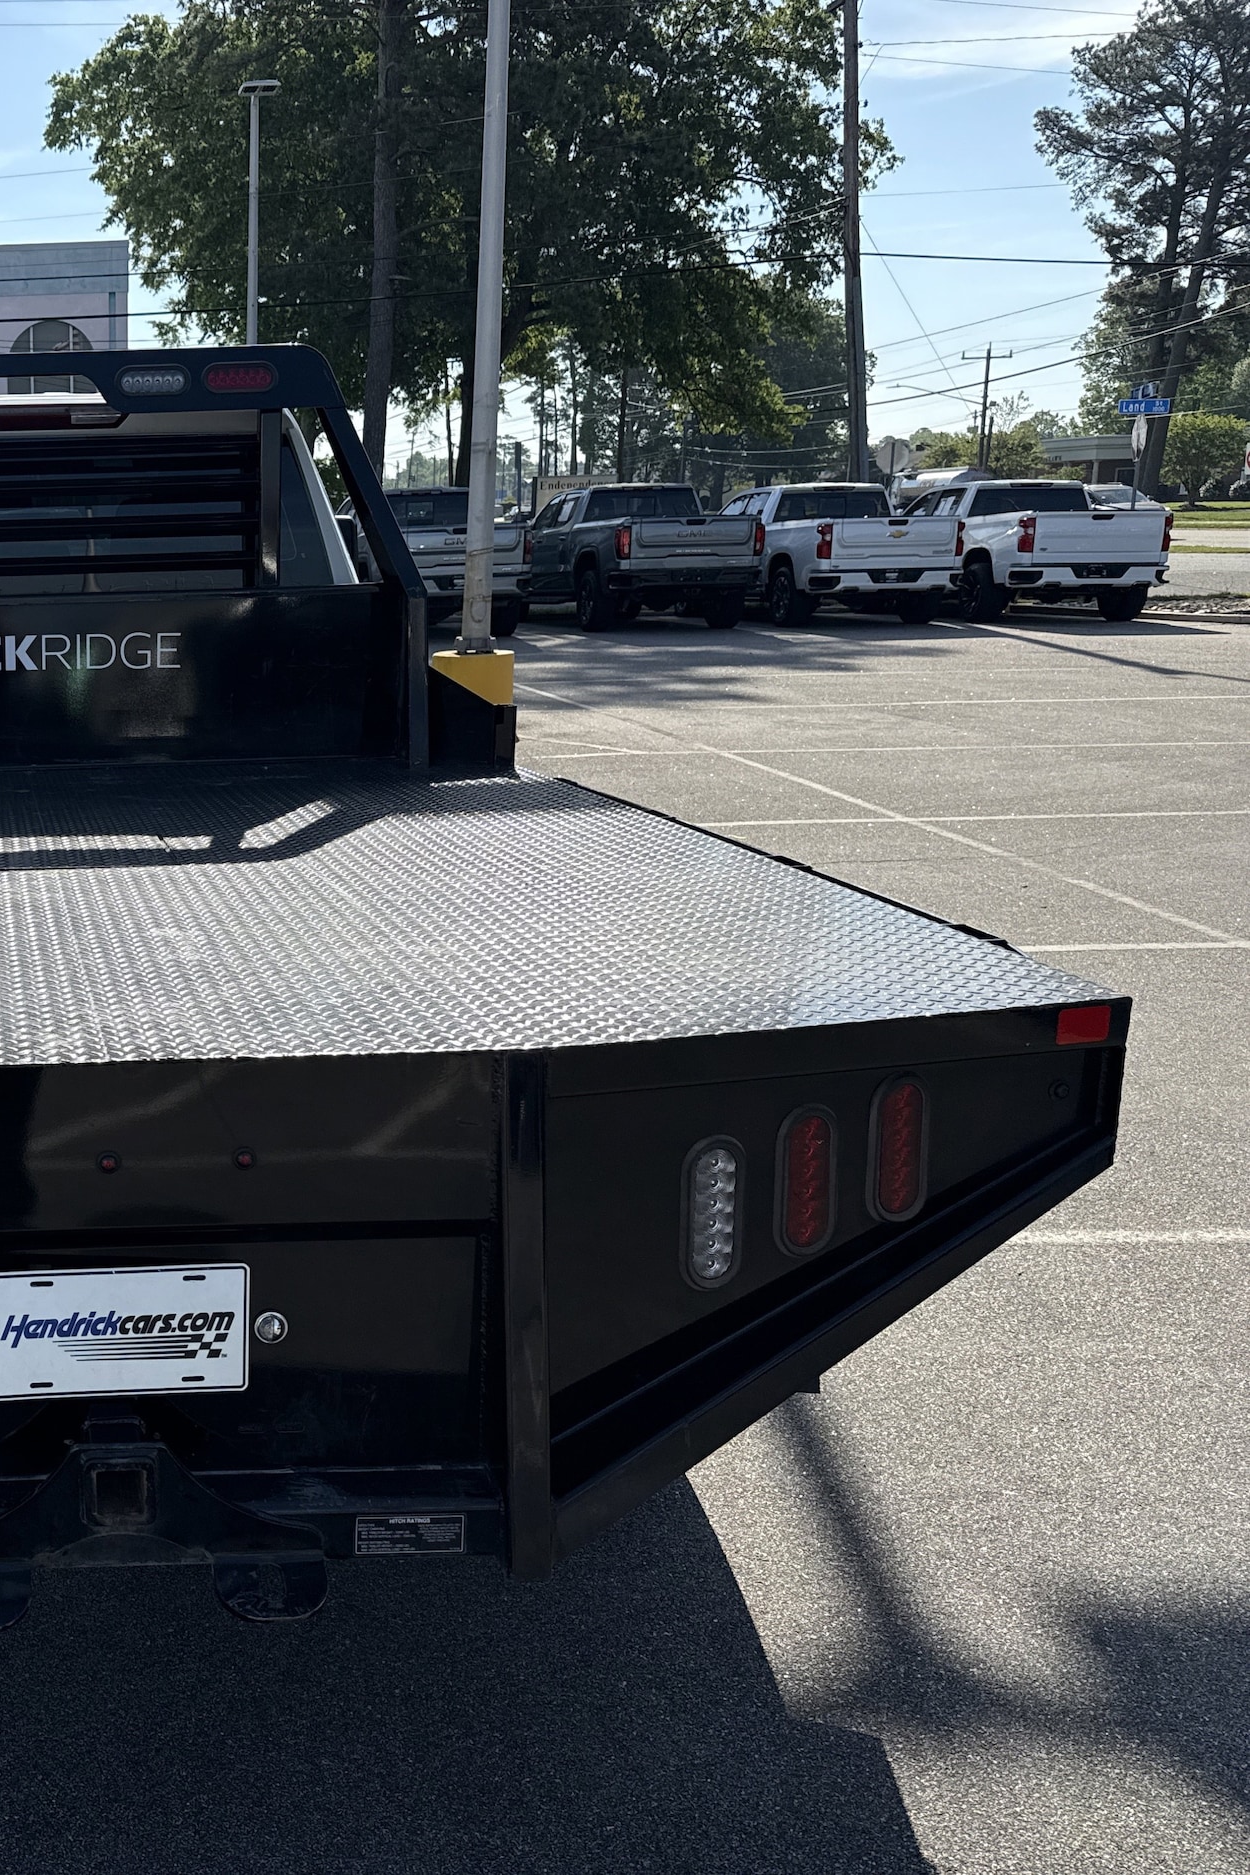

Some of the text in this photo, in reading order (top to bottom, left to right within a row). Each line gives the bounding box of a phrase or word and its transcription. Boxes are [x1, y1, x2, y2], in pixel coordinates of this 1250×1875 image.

[1122, 401, 1146, 412] Land
[444, 537, 467, 546] GM
[0, 1310, 235, 1348] Hendrickcars.com
